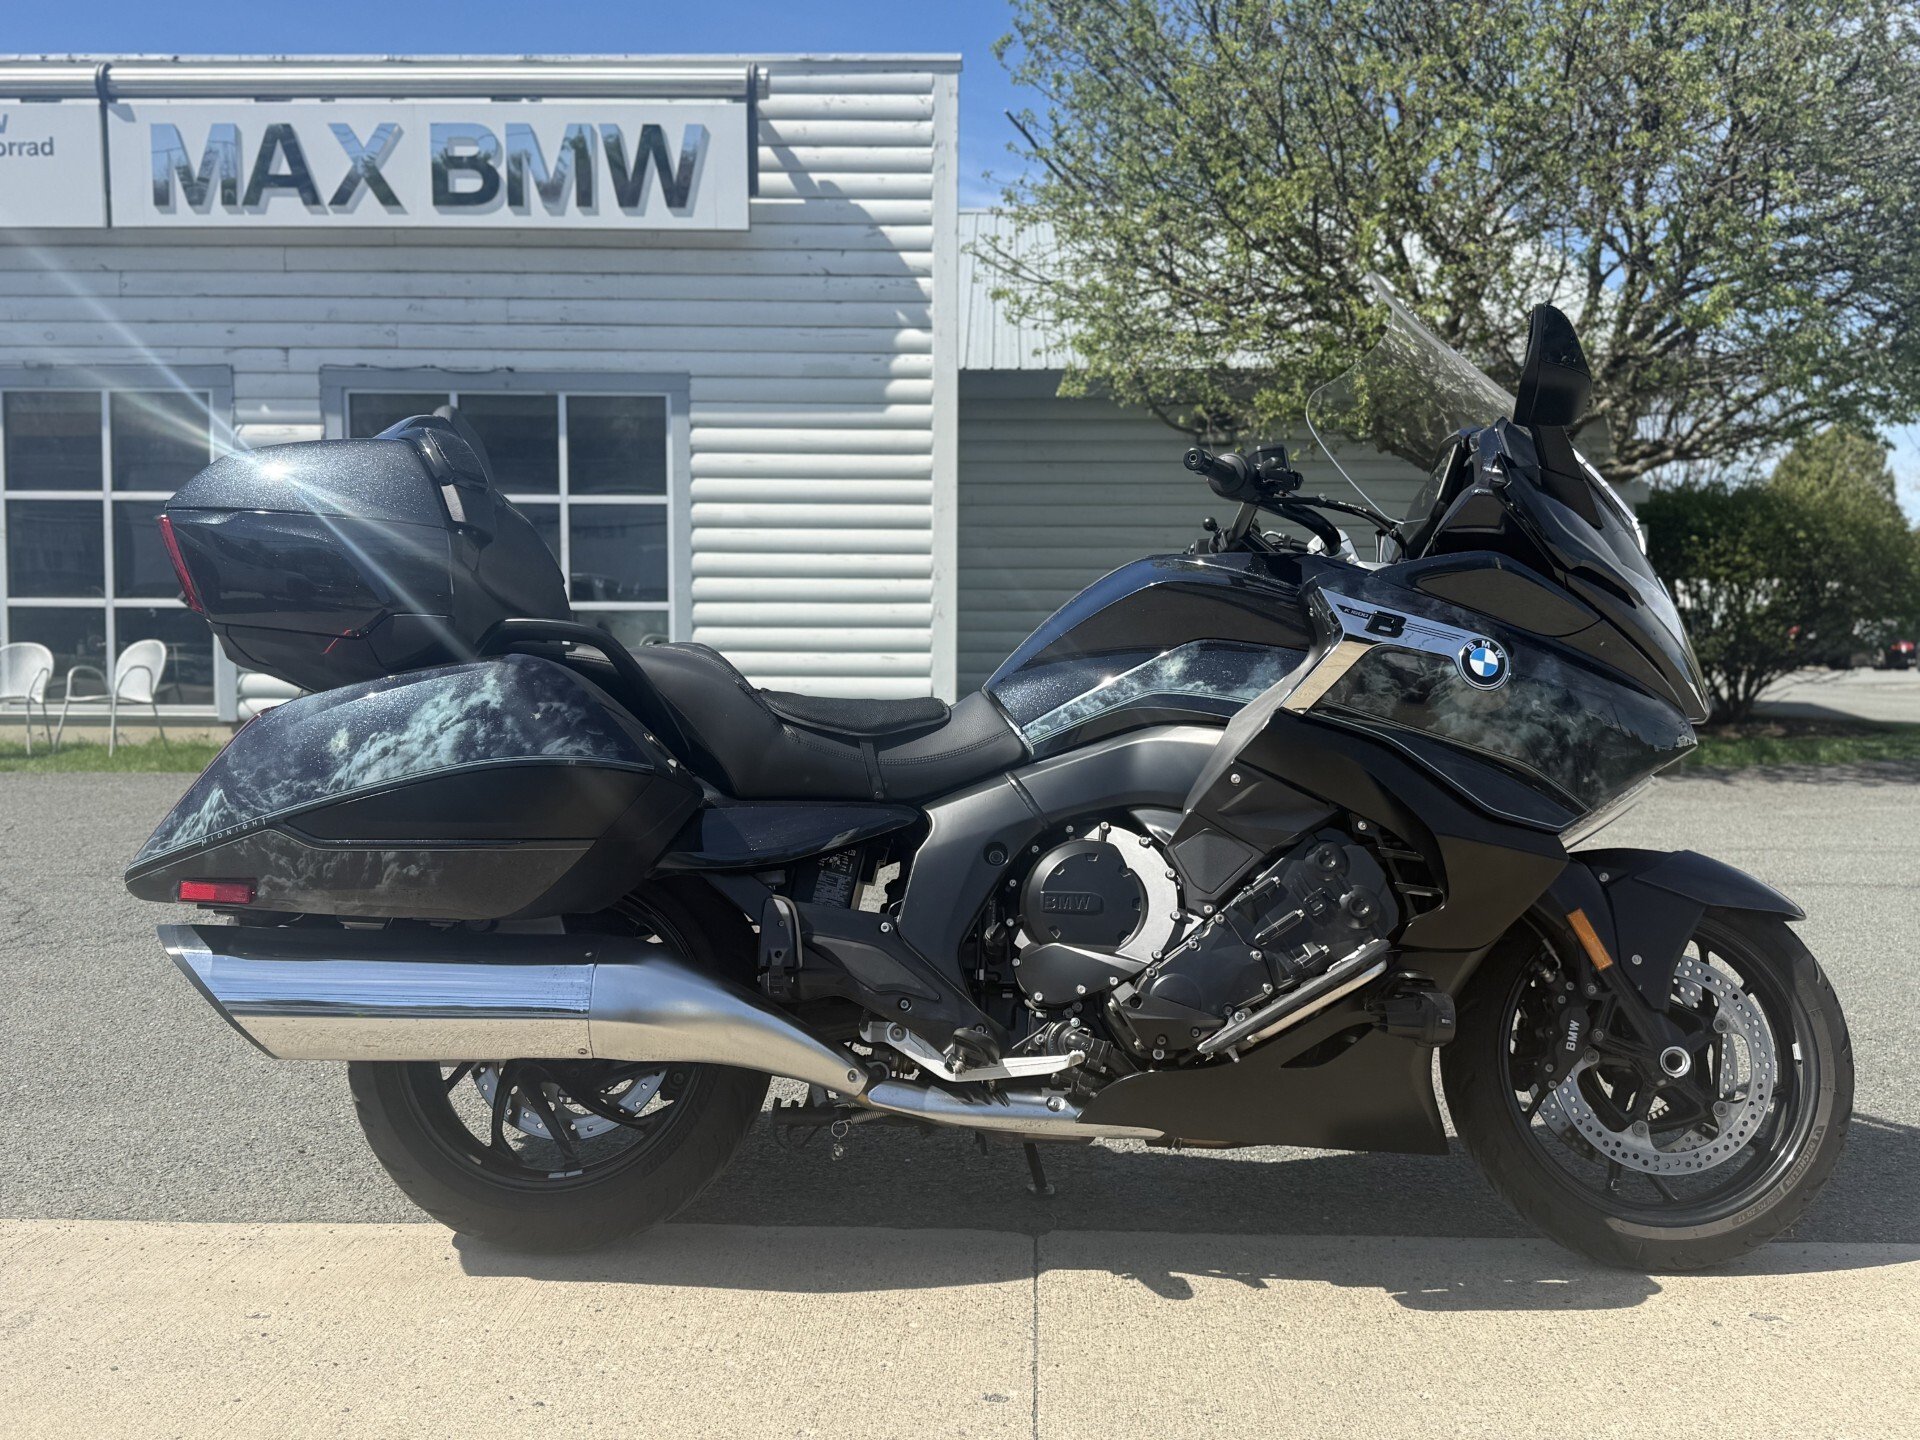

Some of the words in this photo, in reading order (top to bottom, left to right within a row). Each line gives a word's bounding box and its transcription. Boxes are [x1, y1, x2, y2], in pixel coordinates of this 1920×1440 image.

[150, 122, 406, 214] MAX
[429, 122, 708, 216] BMW
[1466, 640, 1505, 660] BMW
[201, 817, 267, 847] MIDNIGHT
[1044, 895, 1091, 910] BMW
[1565, 1019, 1580, 1052] BMW
[1785, 1142, 1817, 1187] MICHELIN
